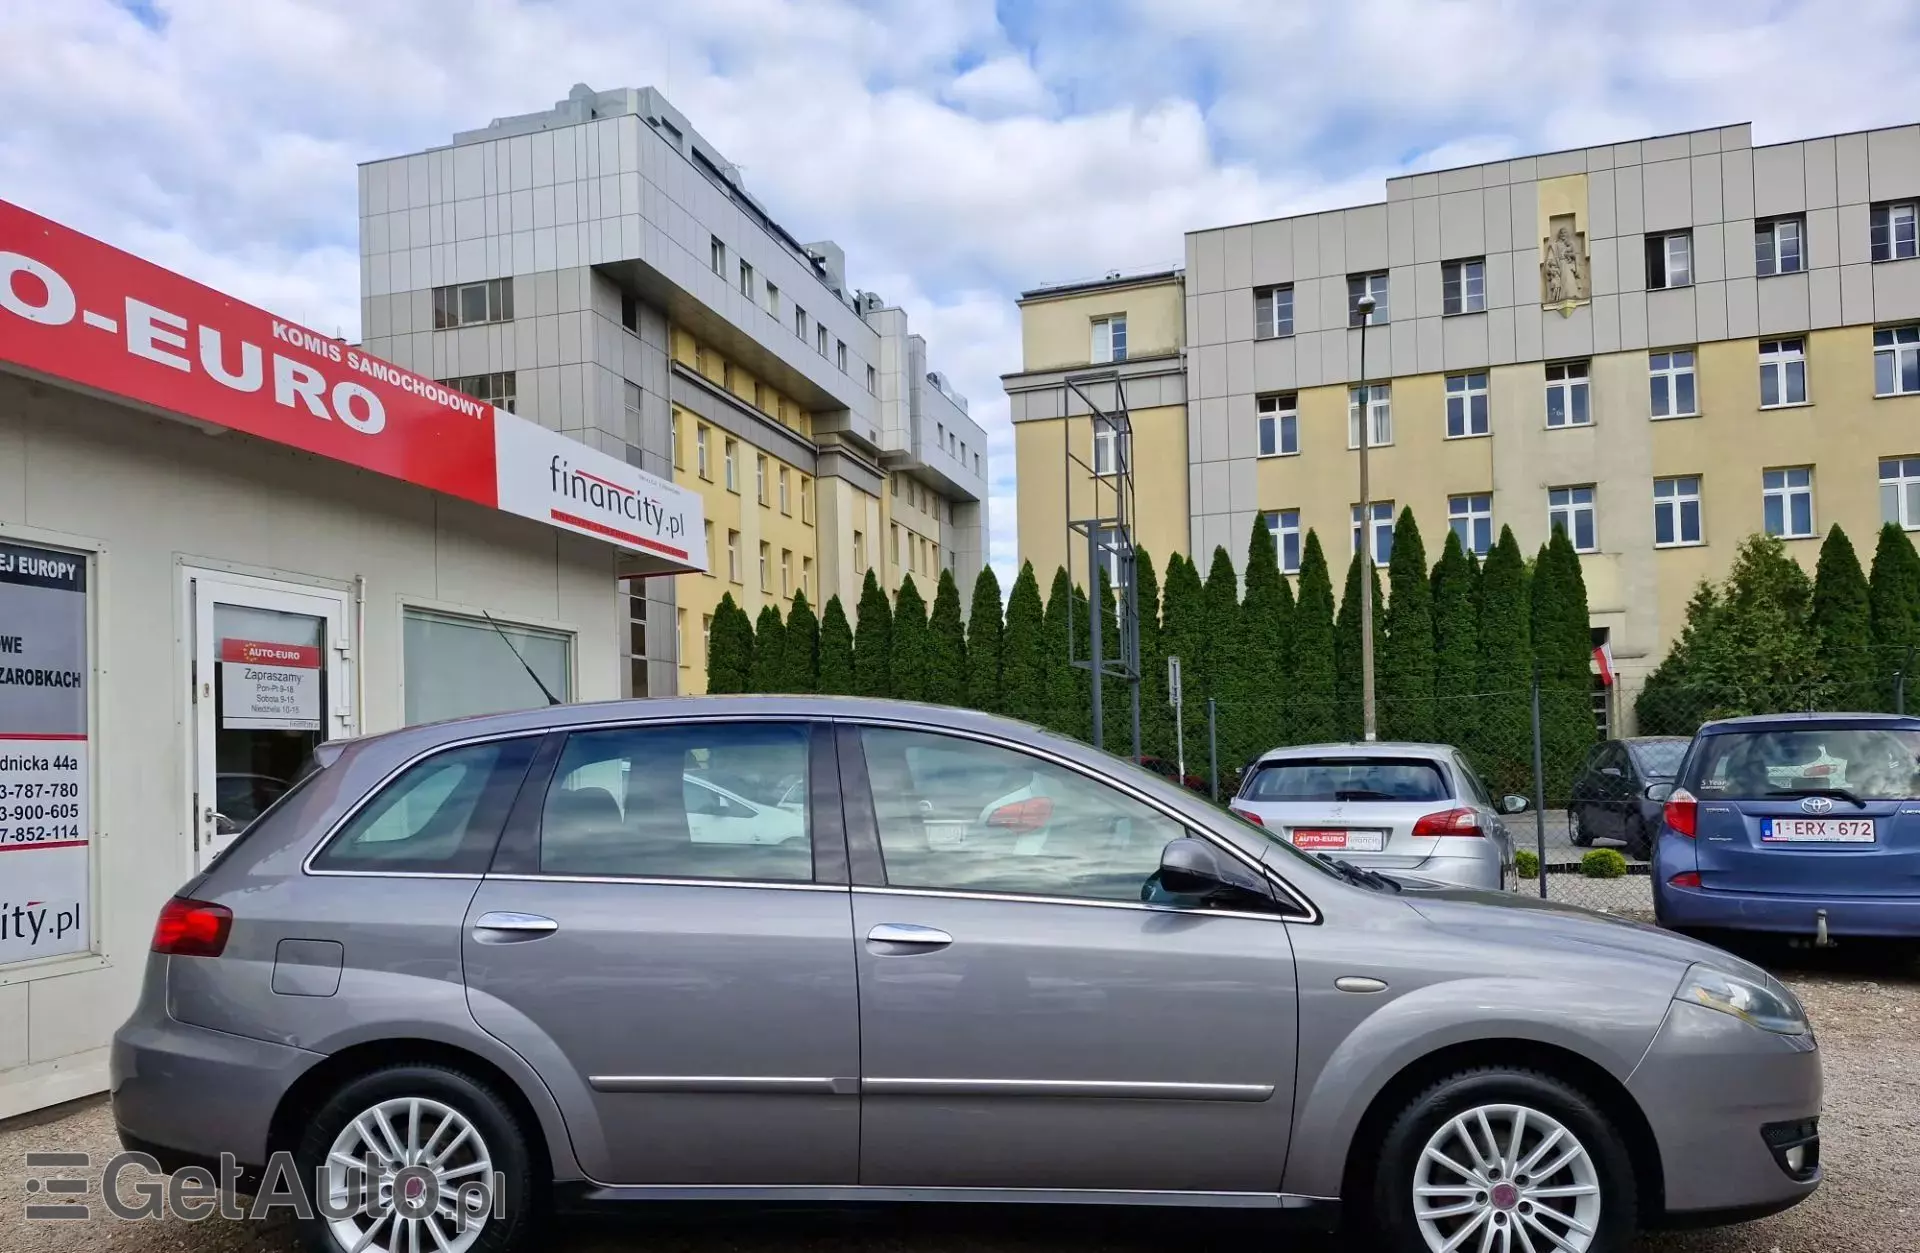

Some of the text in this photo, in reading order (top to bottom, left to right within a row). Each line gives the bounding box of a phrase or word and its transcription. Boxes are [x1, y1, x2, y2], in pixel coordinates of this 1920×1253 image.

[272, 320, 484, 420] KOMIS SAMOCHODOWY
[550, 455, 685, 538] financity.pl
[19, 556, 76, 580] EUROPY
[0, 635, 22, 654] WE
[249, 648, 300, 660] AUTO-EURO
[0, 667, 81, 688] ZAROBKACH
[53, 755, 78, 771] 44a
